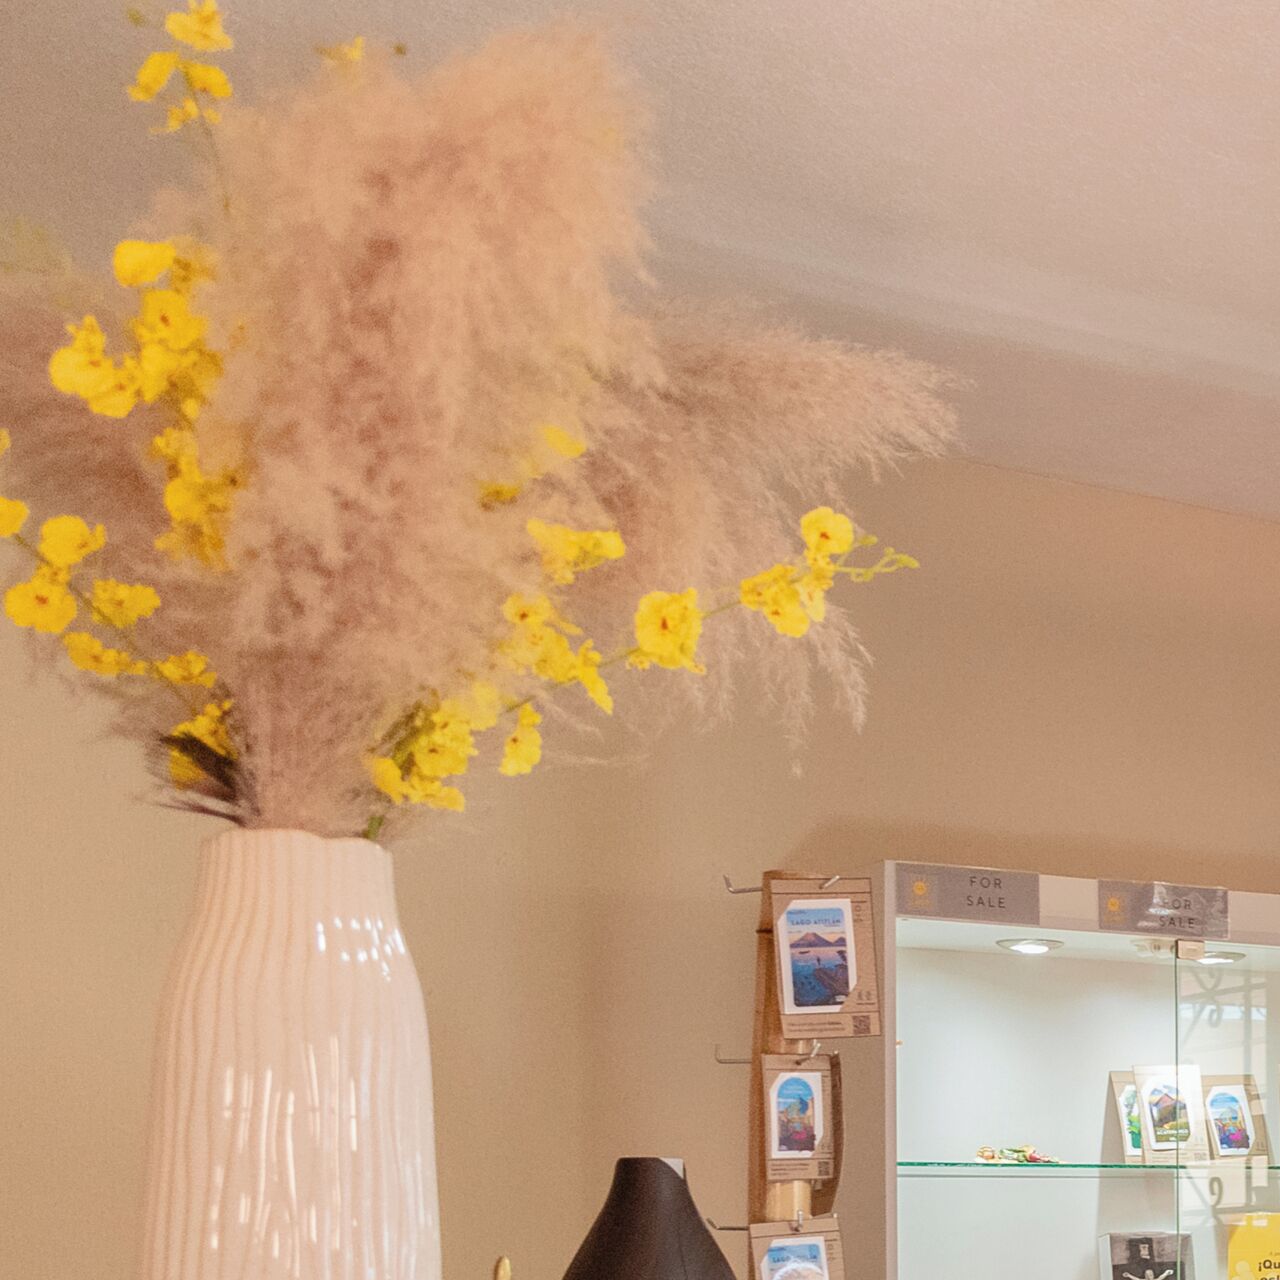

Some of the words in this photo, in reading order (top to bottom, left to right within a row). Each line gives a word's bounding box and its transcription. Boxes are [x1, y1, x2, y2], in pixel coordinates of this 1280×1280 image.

[969, 876, 1003, 889] FOR
[966, 895, 1006, 909] SALE
[1159, 917, 1195, 929] SALE
